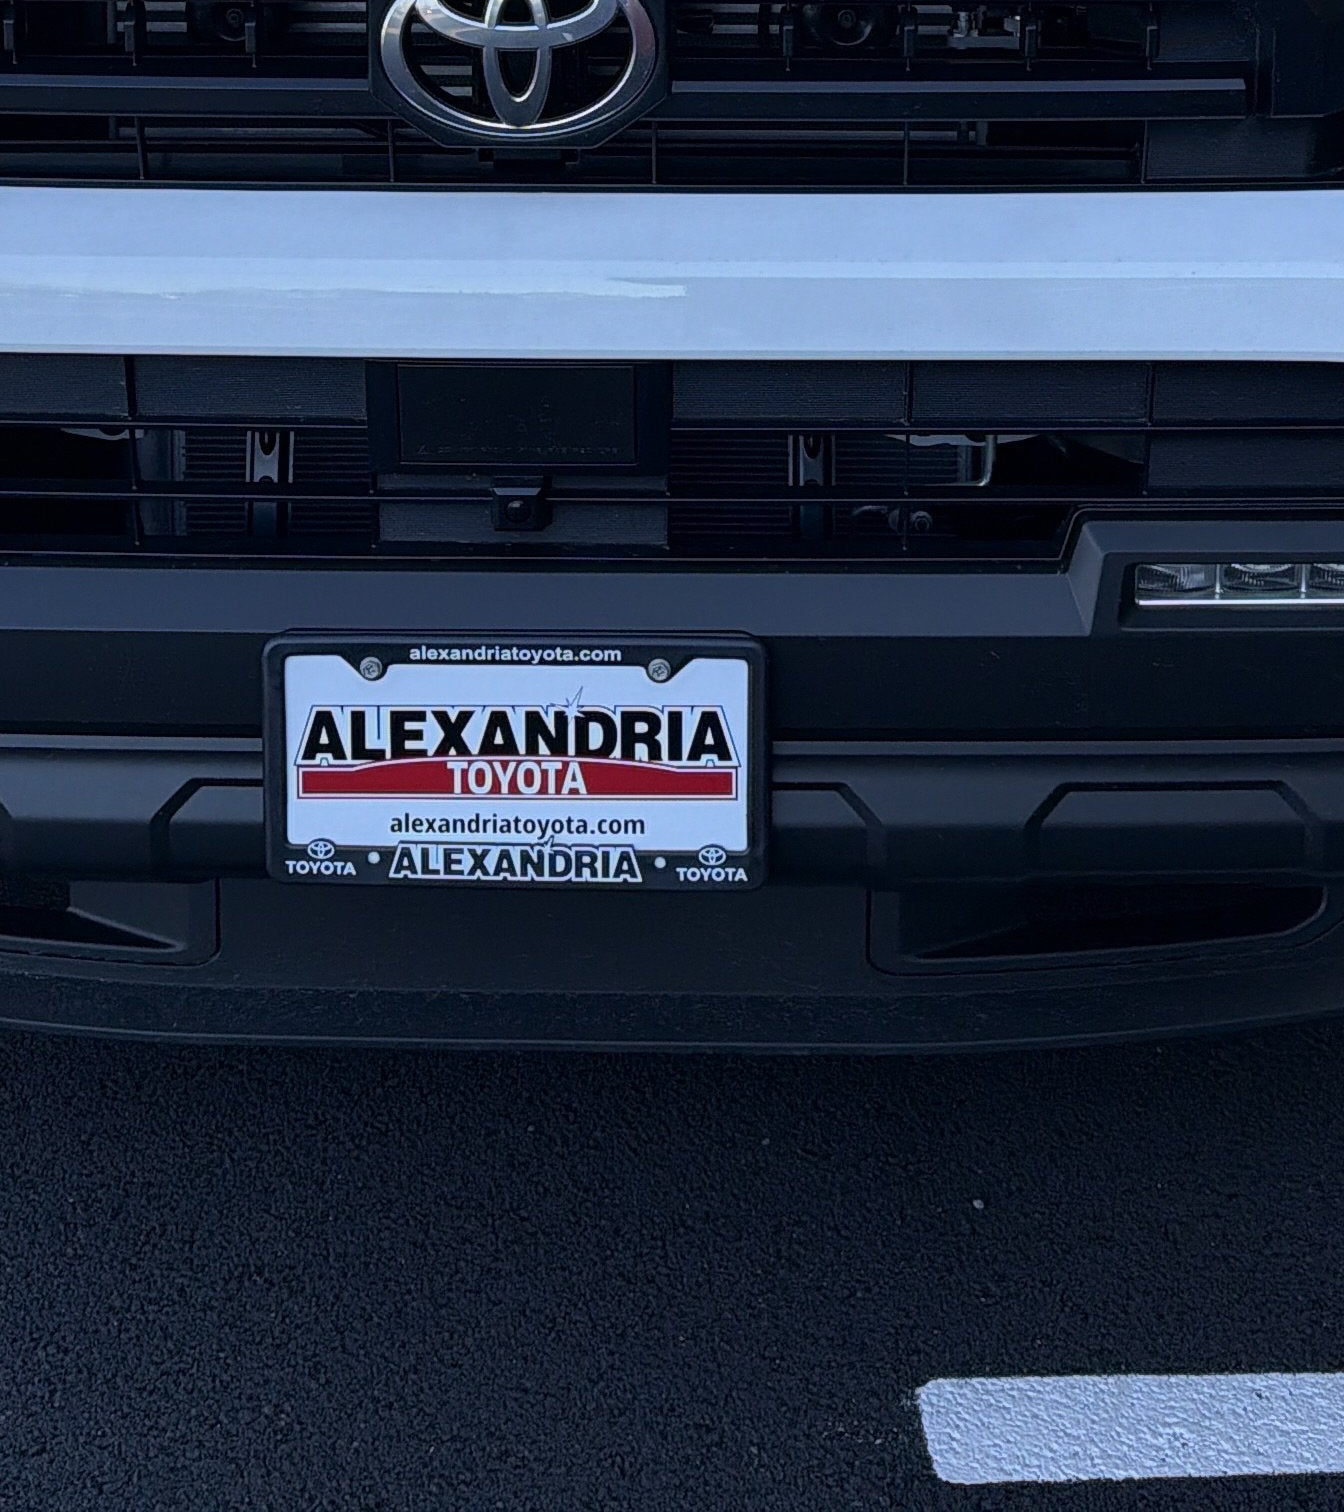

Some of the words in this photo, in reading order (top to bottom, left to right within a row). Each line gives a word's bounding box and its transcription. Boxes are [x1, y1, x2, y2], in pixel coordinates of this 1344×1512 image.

[409, 645, 622, 664] alexandriatoyota.com
[298, 707, 737, 764] ALEXANDRIA
[447, 761, 588, 795] TOYOTA
[390, 813, 645, 839] alexandriatoyota.com
[285, 860, 357, 876] TOYOTA
[390, 843, 642, 882] ALEXANDRIA
[675, 867, 748, 882] TOYOTA
